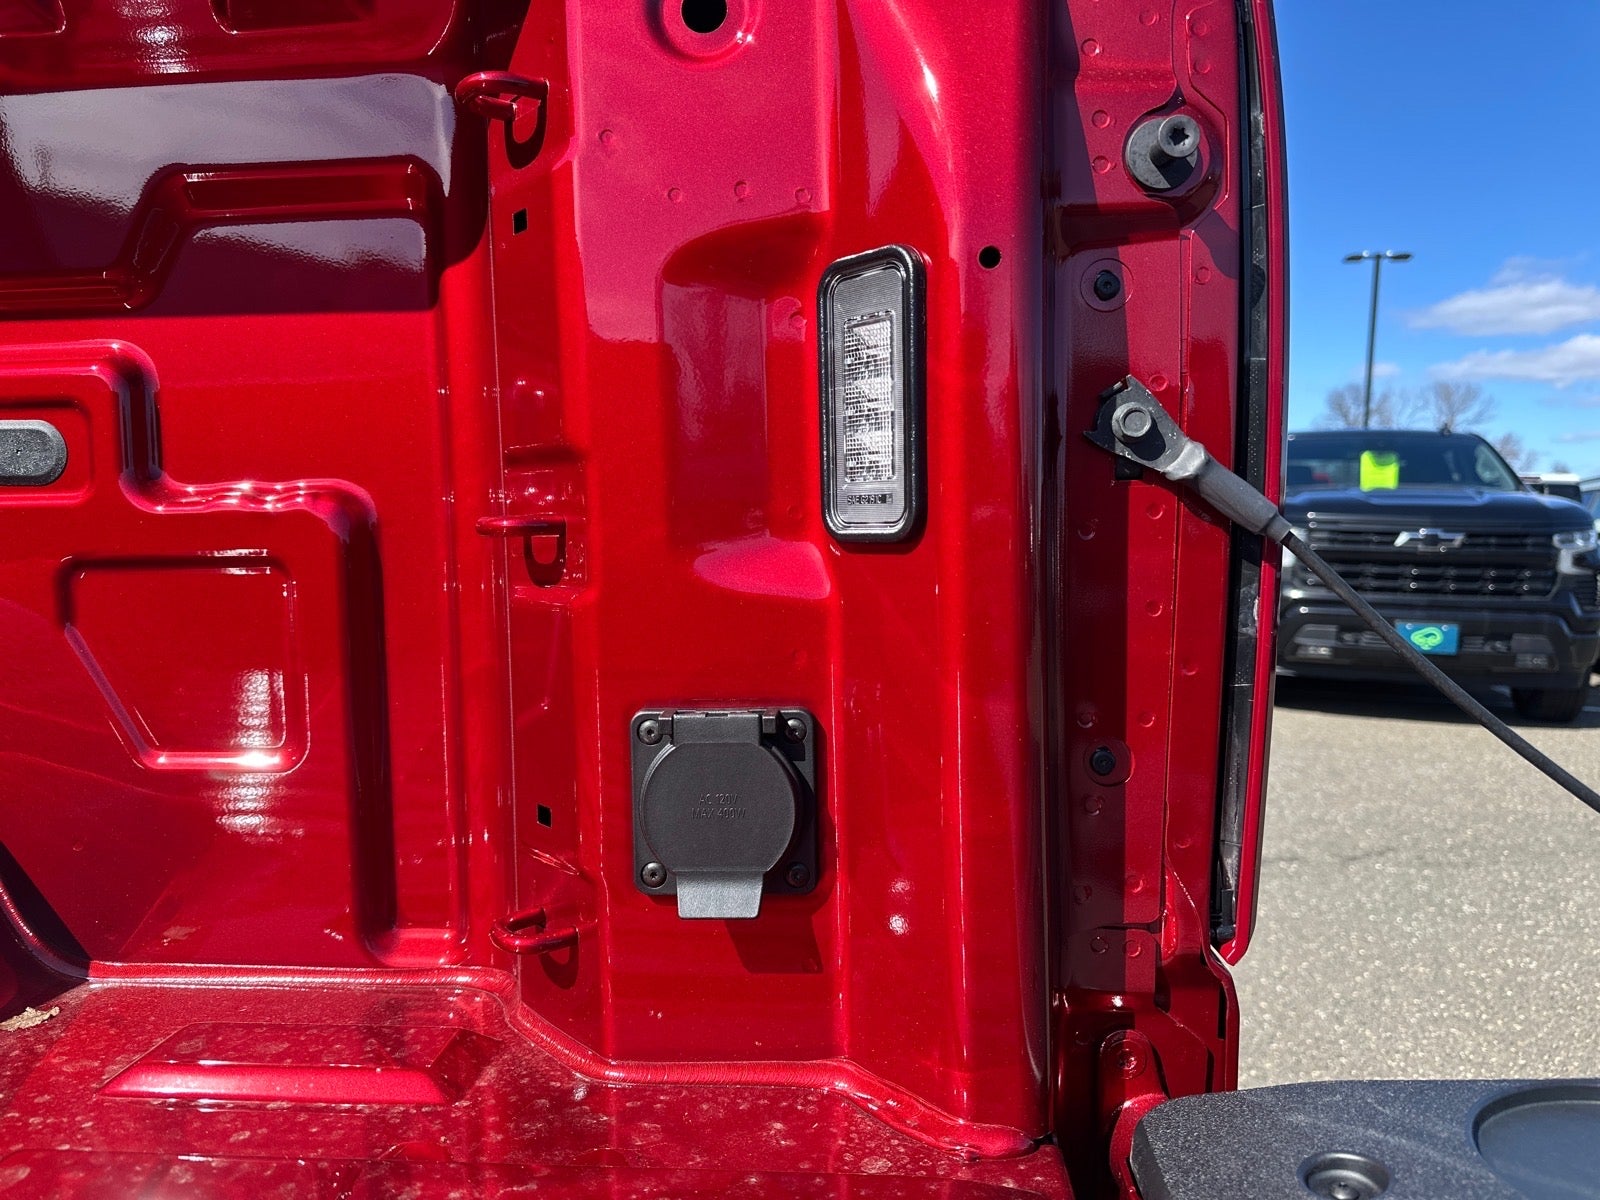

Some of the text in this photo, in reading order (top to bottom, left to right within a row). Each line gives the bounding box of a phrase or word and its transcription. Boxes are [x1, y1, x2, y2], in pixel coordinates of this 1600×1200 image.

[698, 793, 738, 805] AC 120V
[691, 807, 714, 819] MAX
